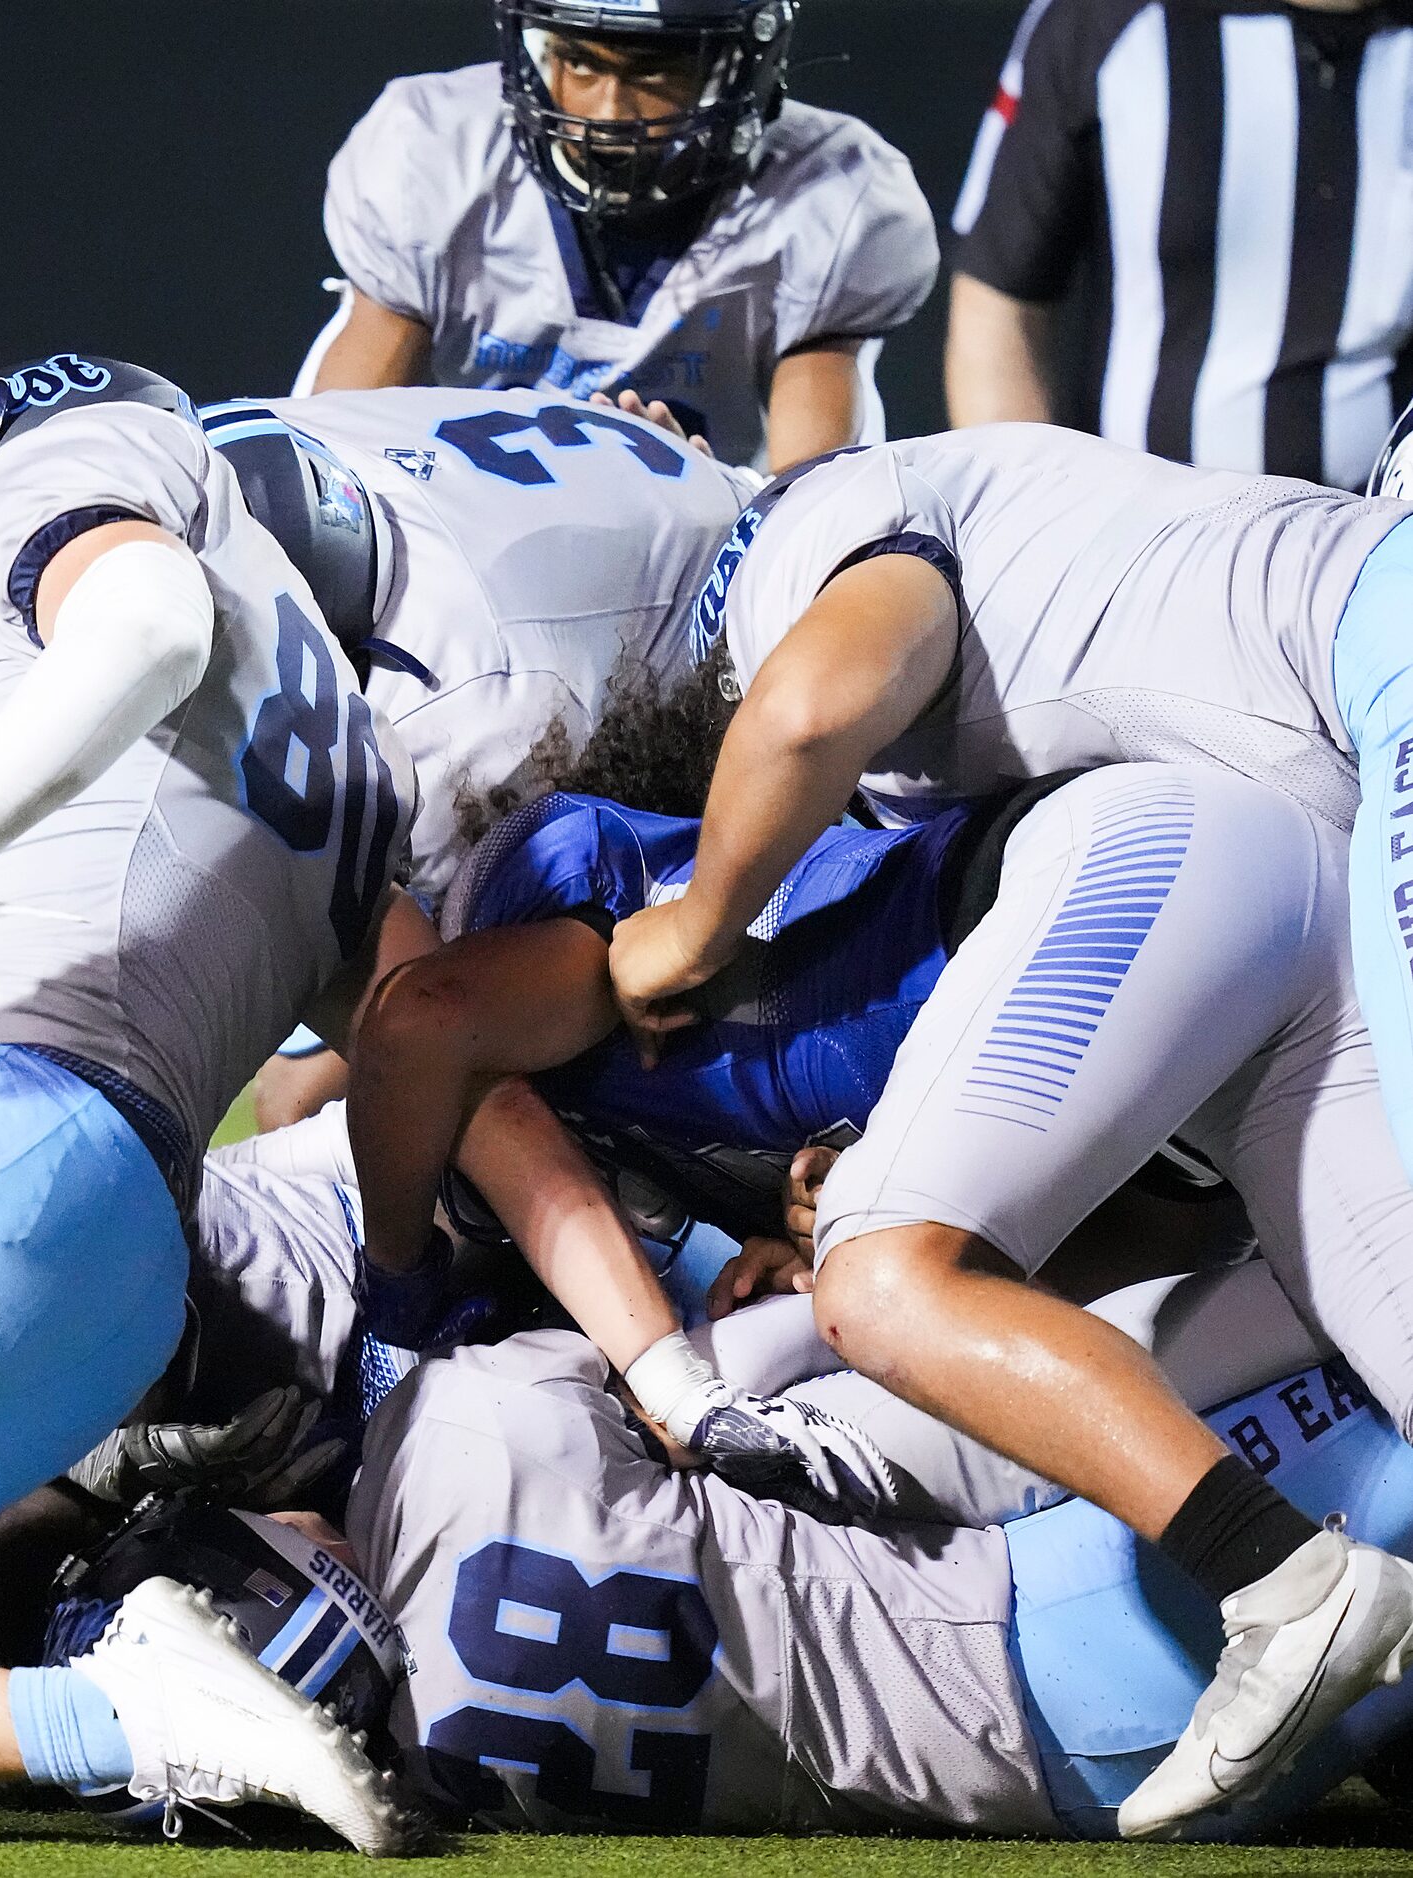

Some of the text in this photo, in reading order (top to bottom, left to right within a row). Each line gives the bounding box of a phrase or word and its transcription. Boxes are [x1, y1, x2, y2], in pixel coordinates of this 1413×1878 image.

[430, 403, 687, 489] 3
[308, 1550, 392, 1648] HARRIS
[424, 1533, 722, 1835] 28
